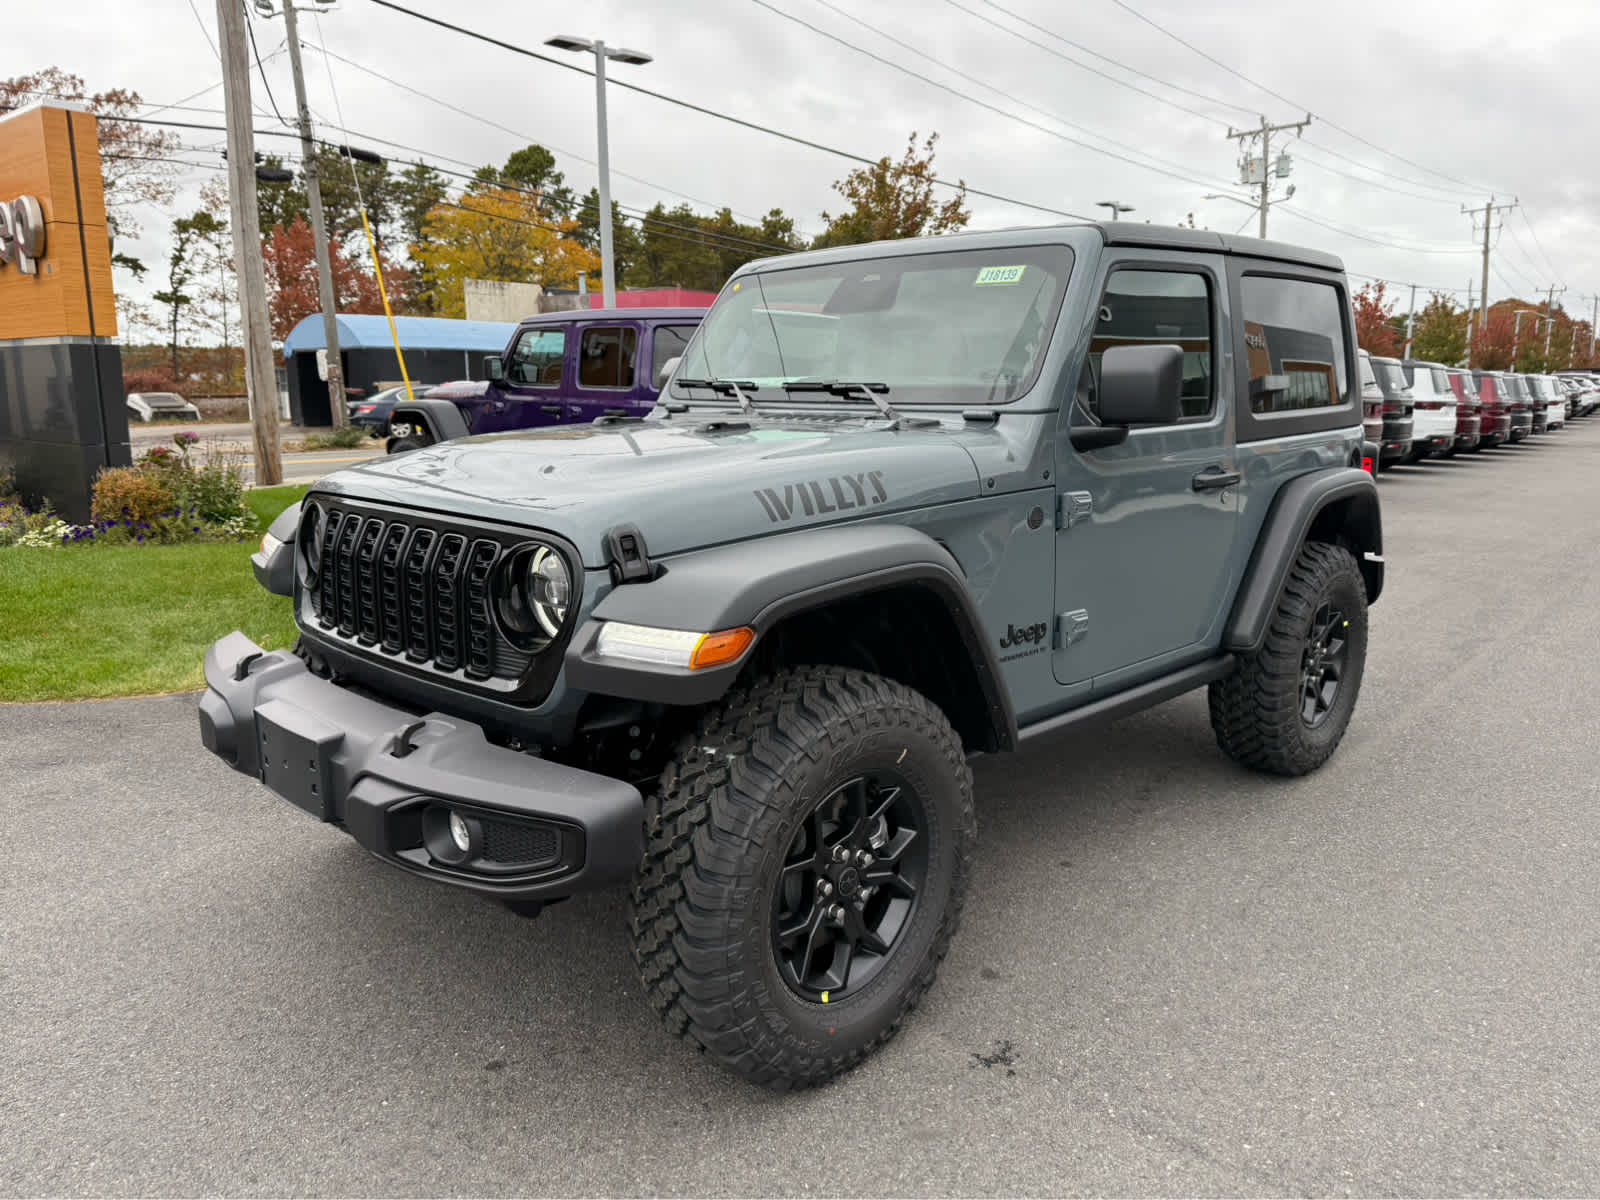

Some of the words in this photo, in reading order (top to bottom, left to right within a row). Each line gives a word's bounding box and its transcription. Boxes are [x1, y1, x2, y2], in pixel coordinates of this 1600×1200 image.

[981, 268, 1018, 281] J18139
[753, 470, 887, 523] WILLYS
[1000, 622, 1047, 649] Jeep
